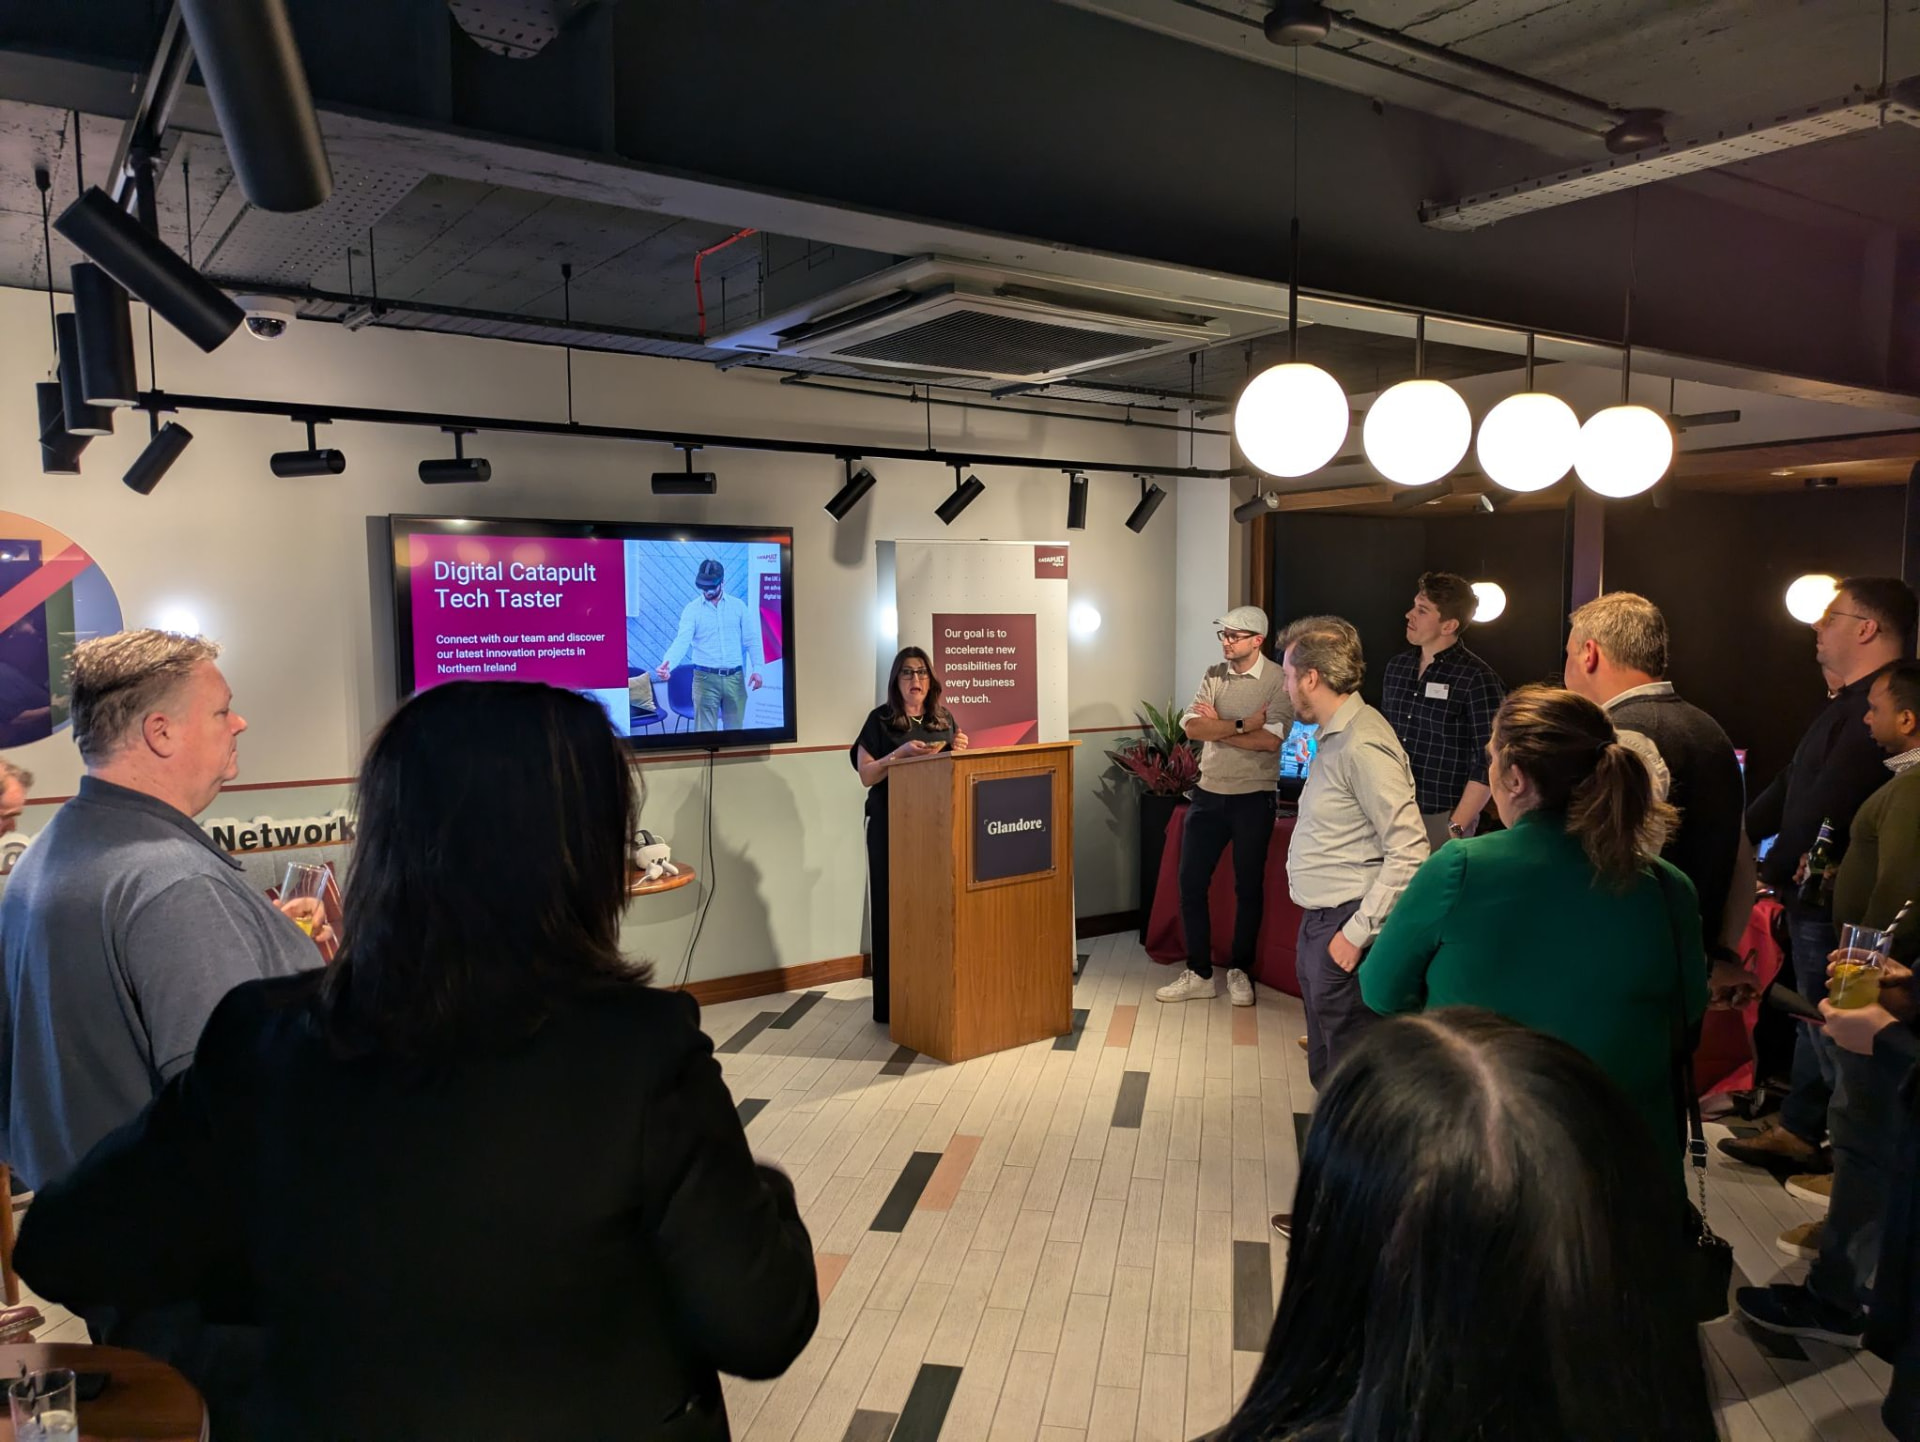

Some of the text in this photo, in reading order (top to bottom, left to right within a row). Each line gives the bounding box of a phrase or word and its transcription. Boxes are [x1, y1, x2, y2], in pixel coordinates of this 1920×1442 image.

[434, 561, 597, 586] Digital Catapult
[434, 588, 563, 608] Tech Taster
[436, 633, 605, 645] Connect with our team and discover
[944, 628, 1007, 640] Our goal is to
[437, 647, 585, 659] our latest innovation projects in
[945, 644, 1016, 655] accelerate new
[437, 662, 517, 674] Northern Ireland
[945, 660, 1018, 673] possibilities for
[945, 677, 1015, 690] every business
[945, 693, 991, 704] we touch.
[212, 815, 356, 851] Network
[987, 818, 1043, 836] Glandore
